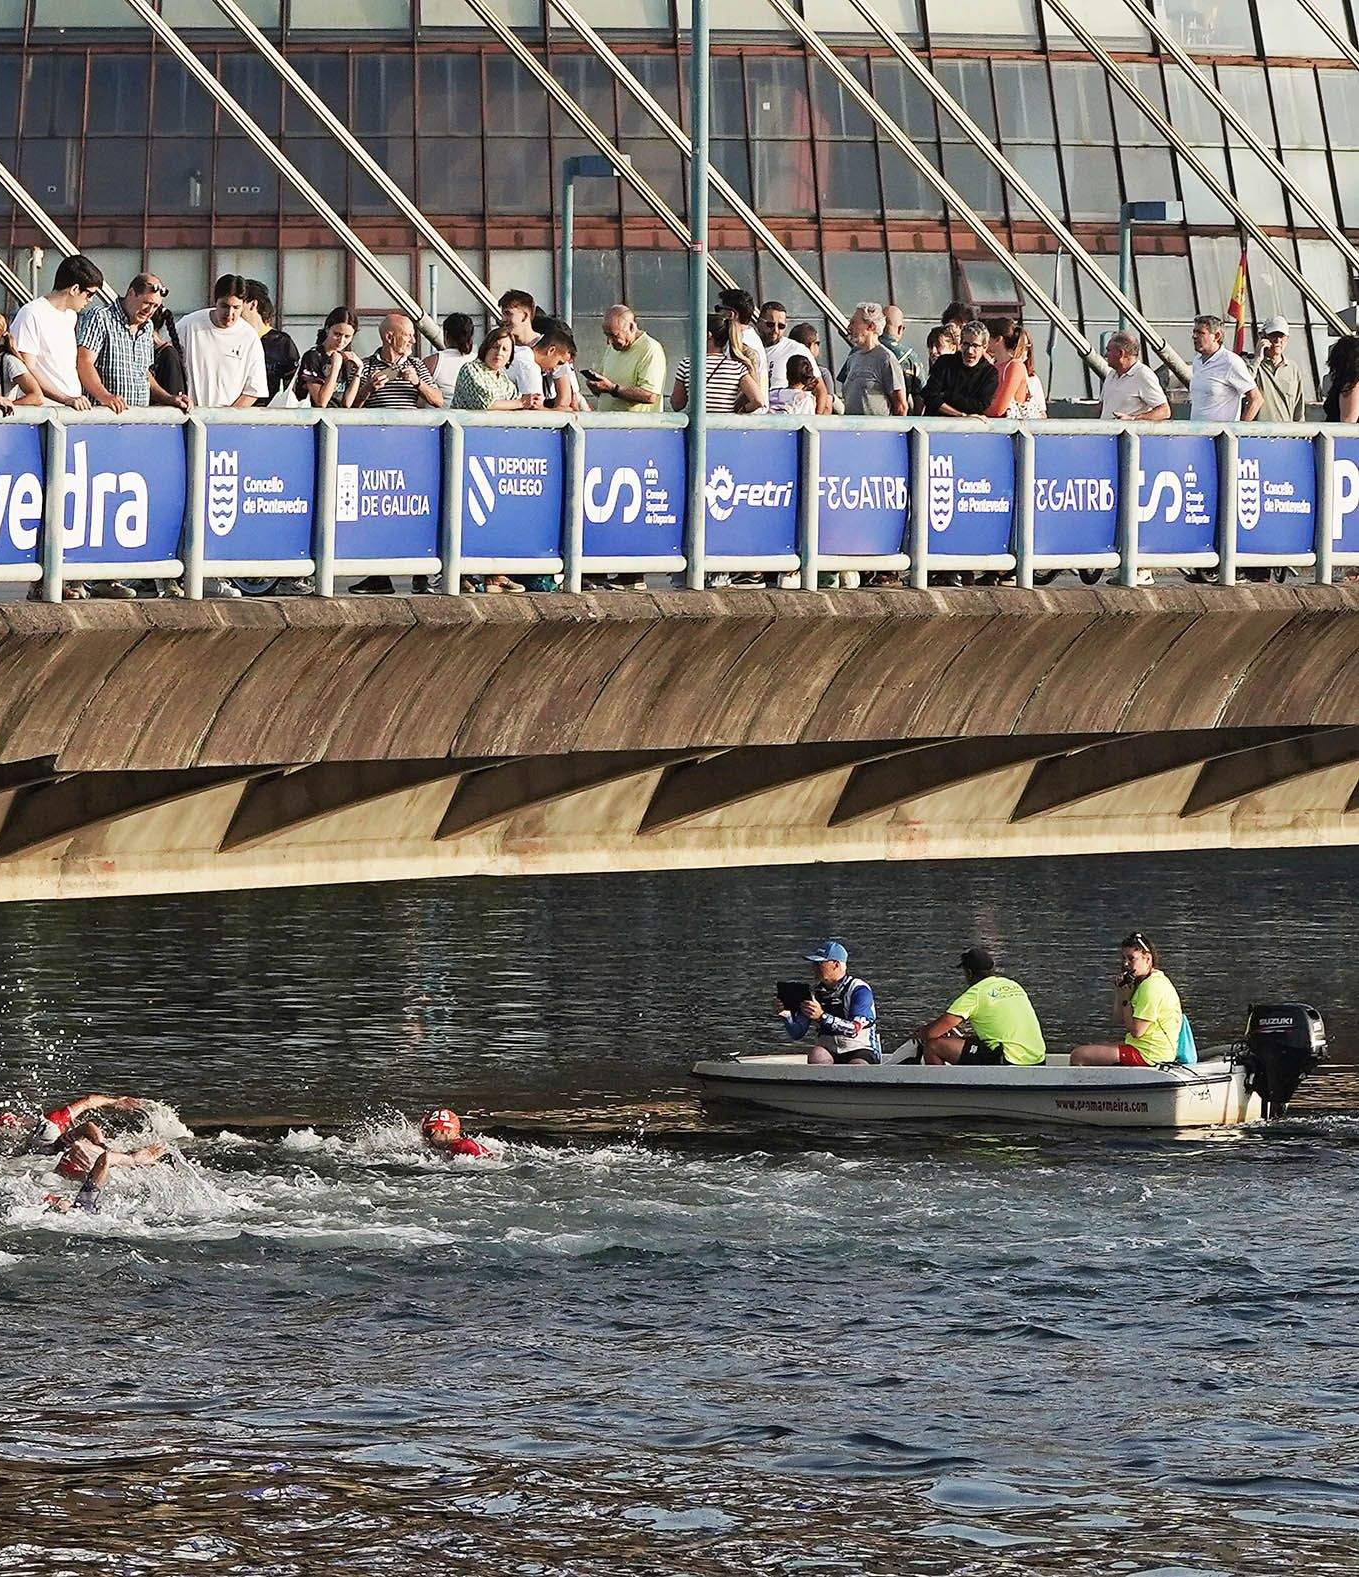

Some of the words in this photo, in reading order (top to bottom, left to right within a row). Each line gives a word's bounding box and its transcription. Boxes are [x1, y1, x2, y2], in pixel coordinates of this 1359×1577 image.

[498, 458, 548, 476] DEPORTE
[243, 476, 284, 494] Concello
[361, 469, 406, 491] XUNTA
[498, 478, 543, 496] GALEGO
[243, 497, 256, 514] de
[257, 497, 308, 514] Pontevedra
[361, 496, 379, 516] DE
[381, 494, 430, 517] GALICIA
[1259, 1017, 1294, 1026] SUZUKI
